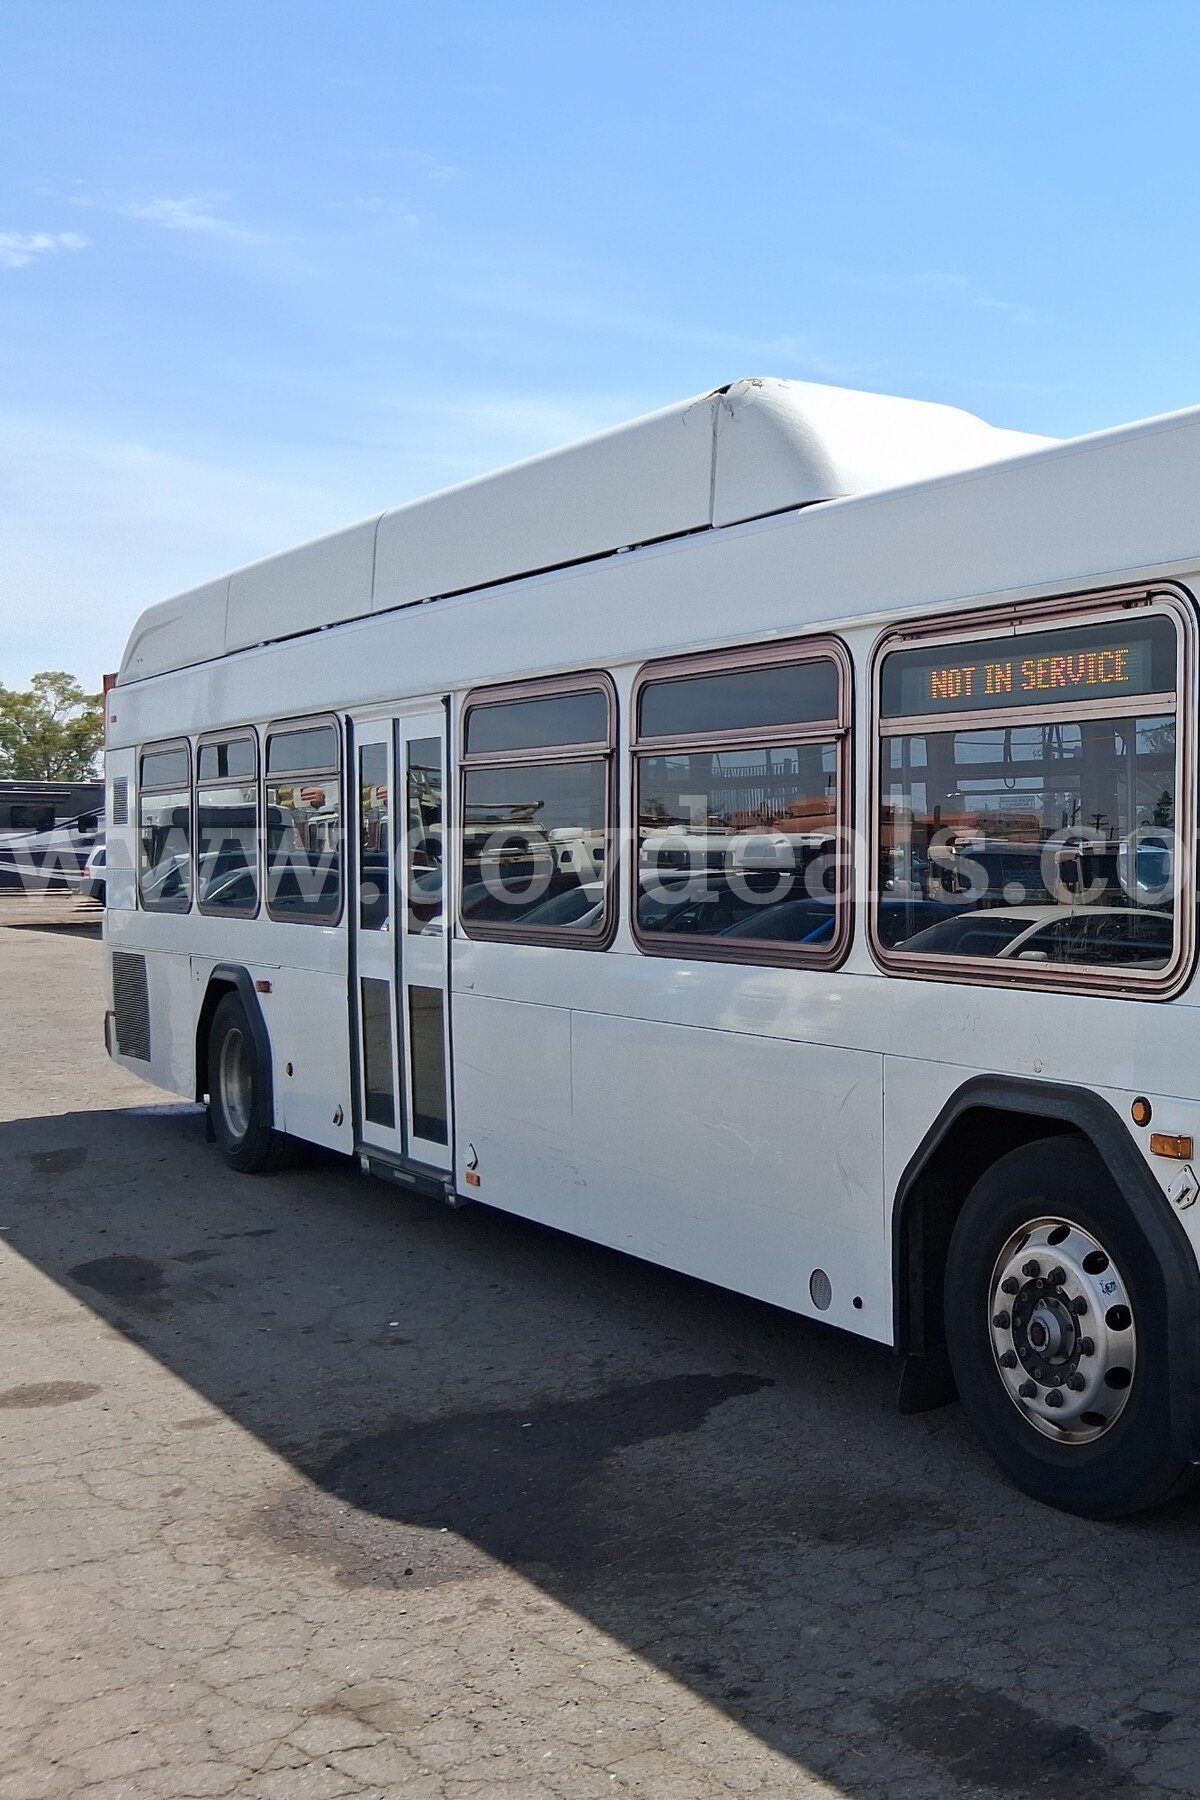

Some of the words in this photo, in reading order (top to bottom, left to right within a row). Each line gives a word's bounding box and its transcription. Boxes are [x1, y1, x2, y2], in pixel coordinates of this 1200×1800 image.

[930, 665, 976, 699] NOT
[984, 661, 1013, 695] IN
[1020, 648, 1130, 690] SERVICE
